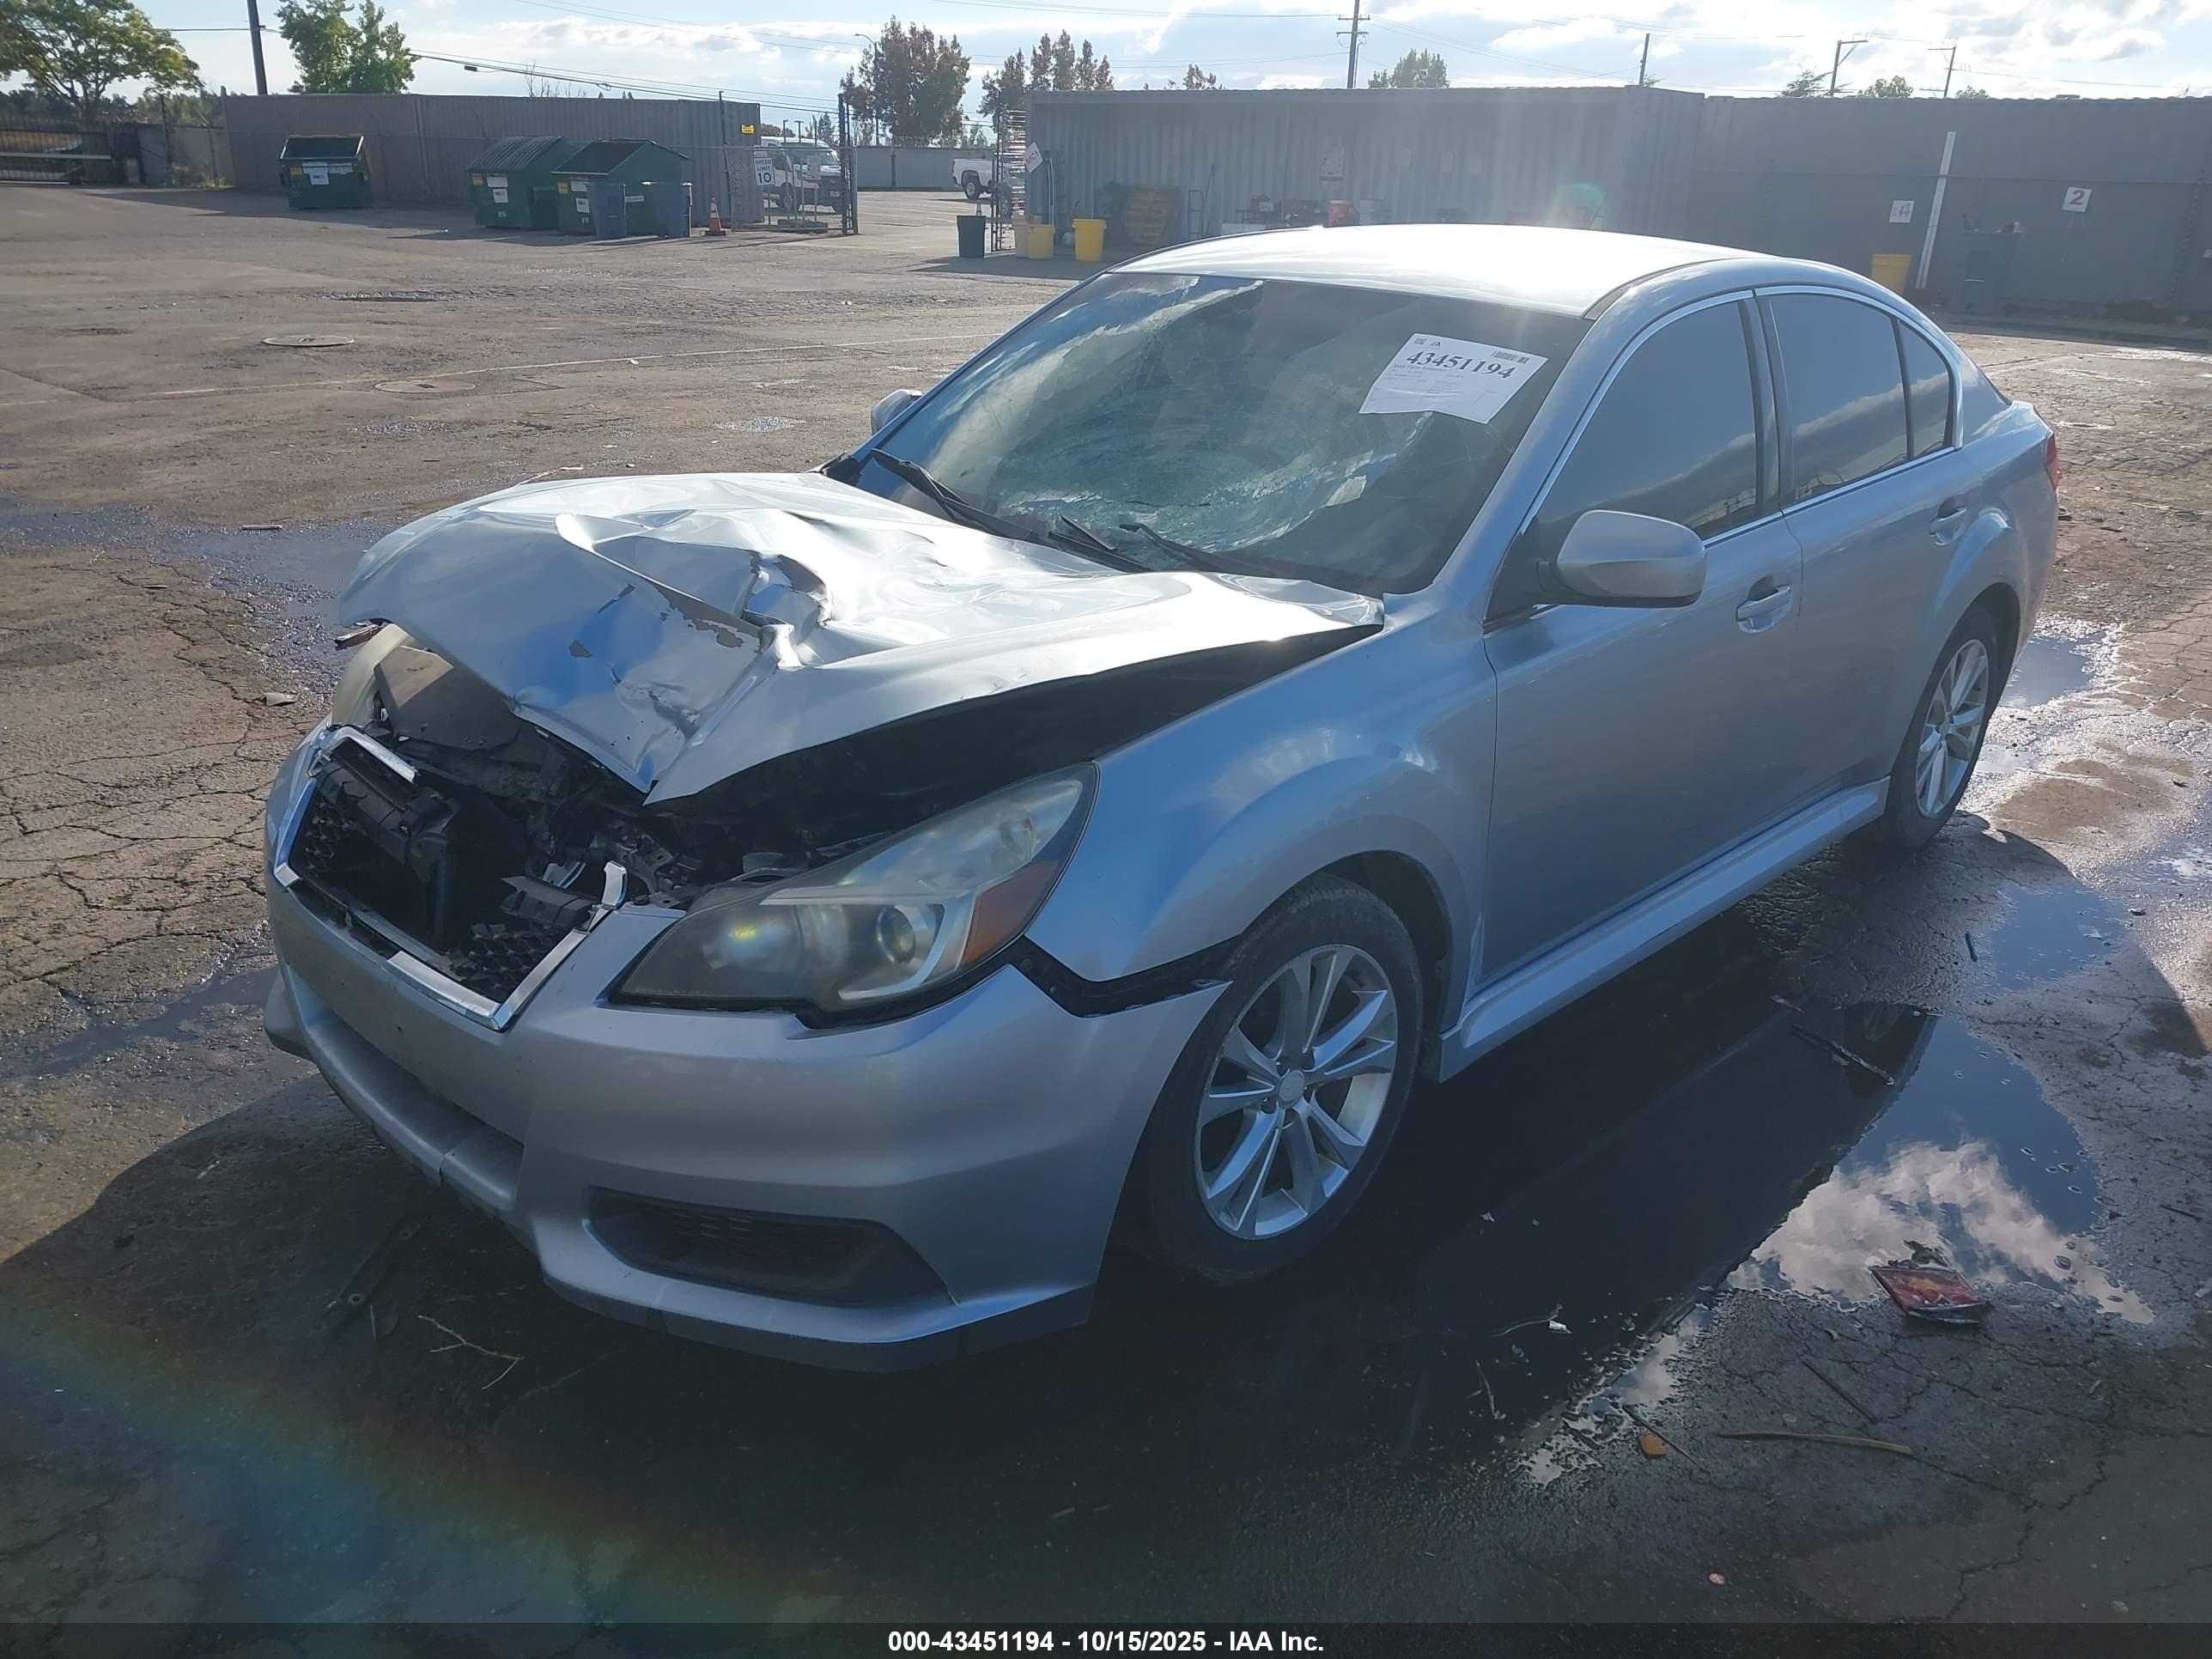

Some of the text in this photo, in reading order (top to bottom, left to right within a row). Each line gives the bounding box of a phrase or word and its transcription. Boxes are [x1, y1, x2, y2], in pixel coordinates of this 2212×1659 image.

[758, 173, 771, 183] 10
[2069, 190, 2085, 205] 2
[1407, 351, 1516, 378] 43451194
